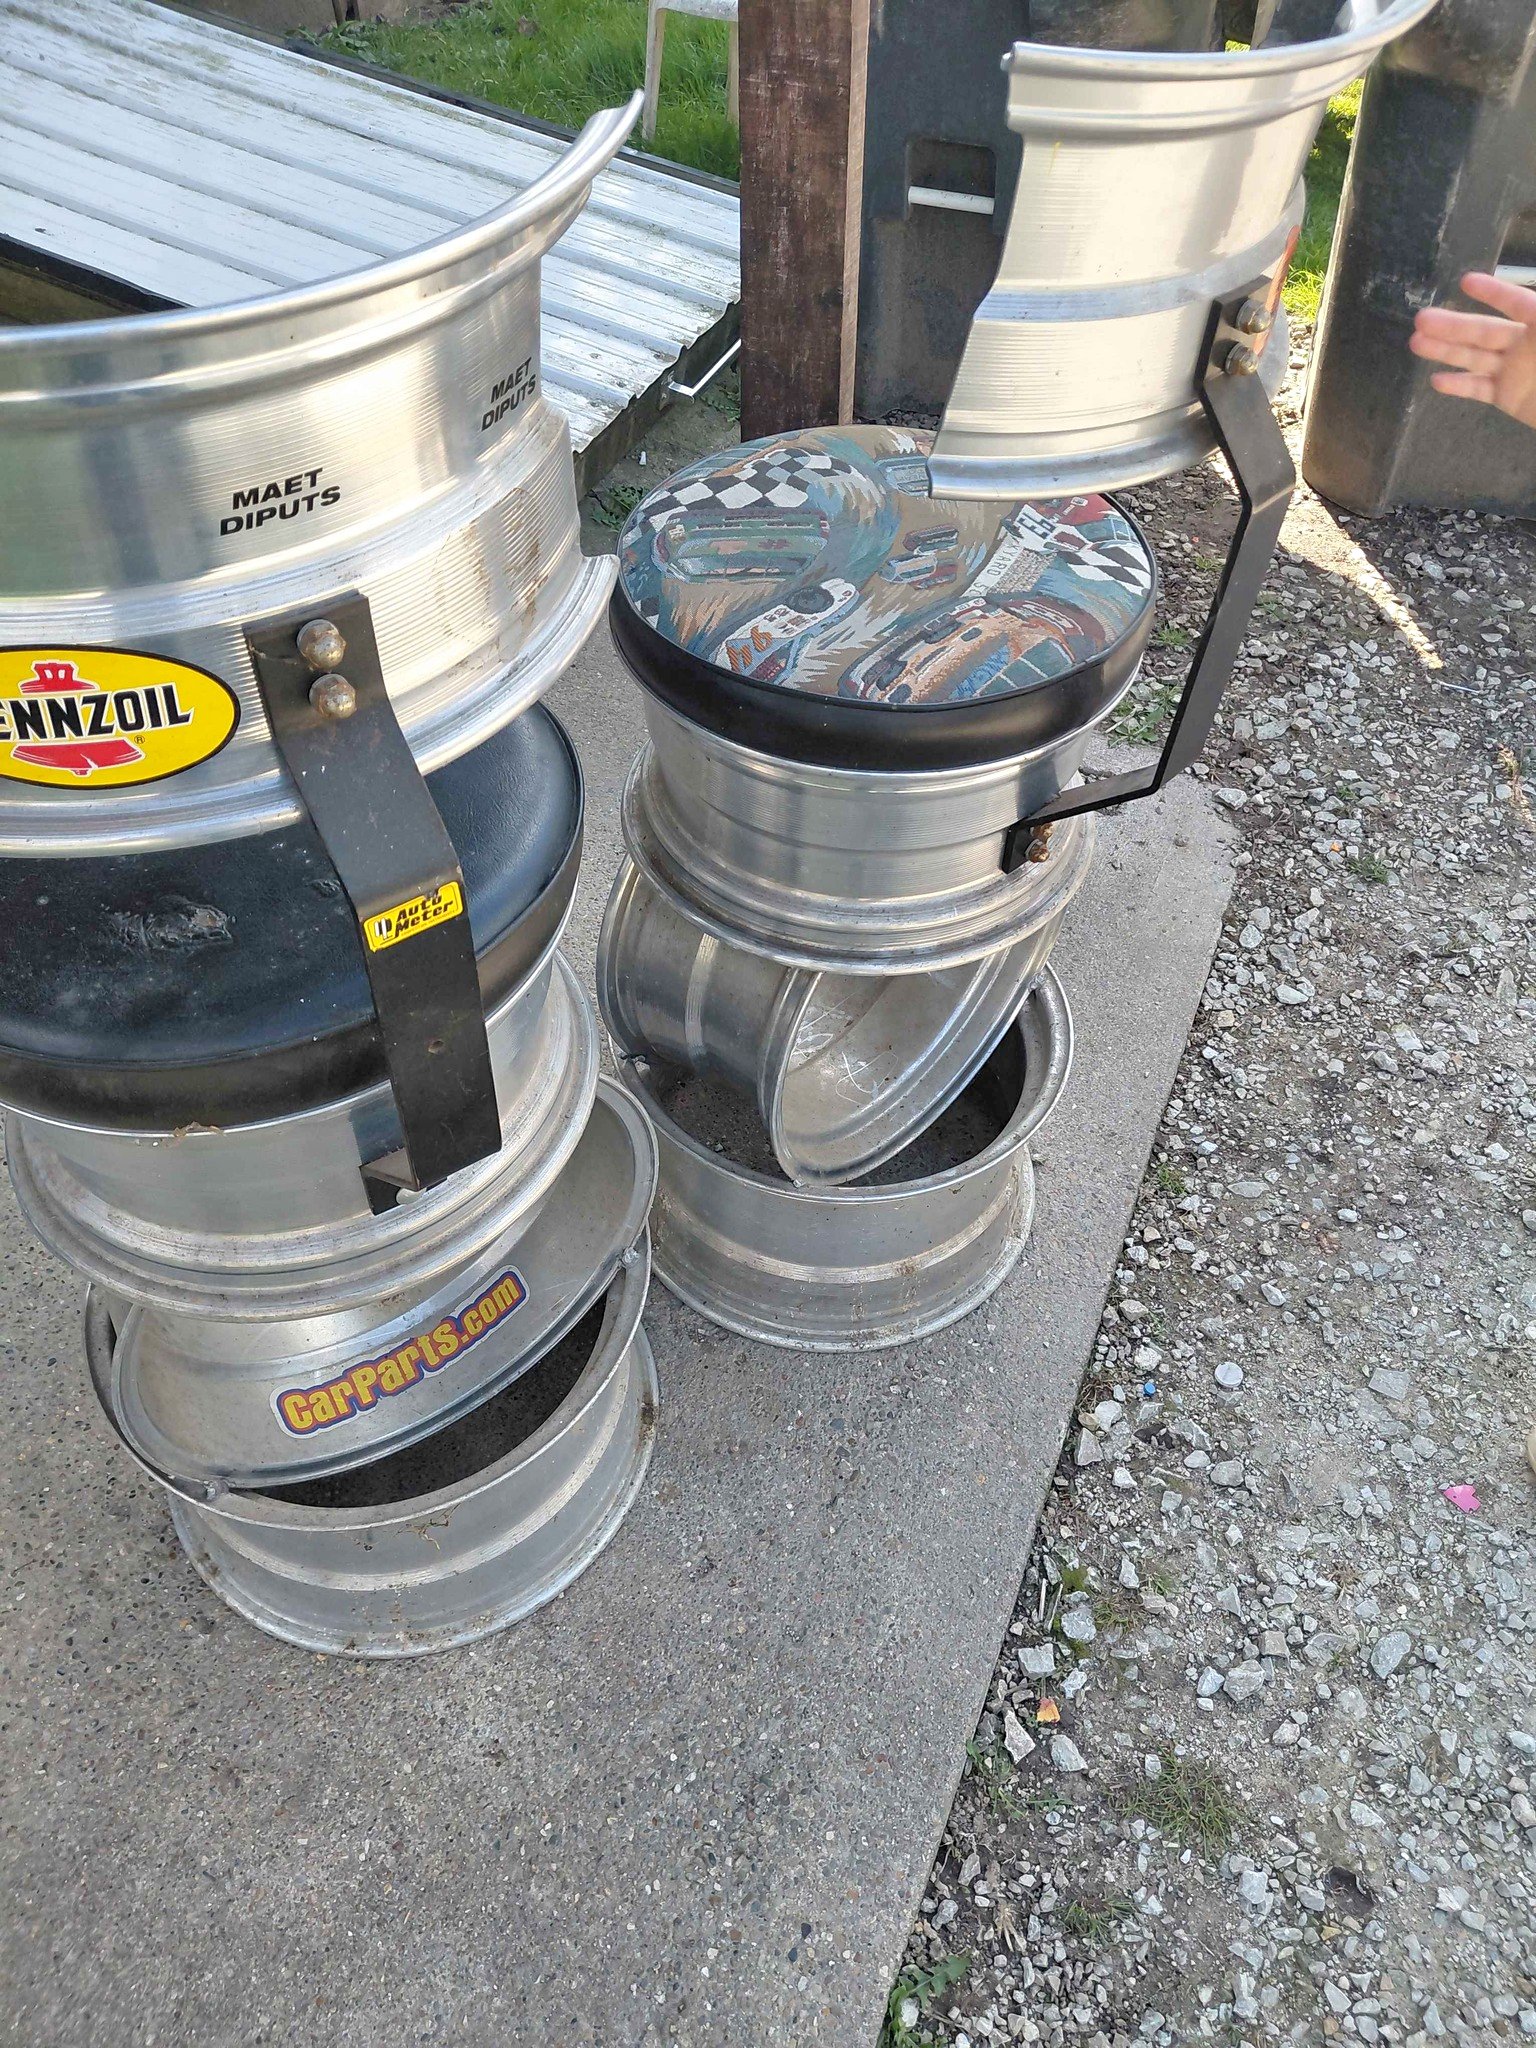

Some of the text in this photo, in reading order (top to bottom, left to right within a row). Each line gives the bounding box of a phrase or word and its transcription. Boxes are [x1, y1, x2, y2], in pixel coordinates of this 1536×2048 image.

[481, 374, 536, 432] DIPUTS
[491, 356, 532, 404] MAET
[220, 485, 341, 536] DIPUTS
[232, 467, 323, 510] MAET
[395, 900, 453, 938] Meter
[396, 894, 442, 922] Auto
[282, 1277, 520, 1430] CarParts.com
